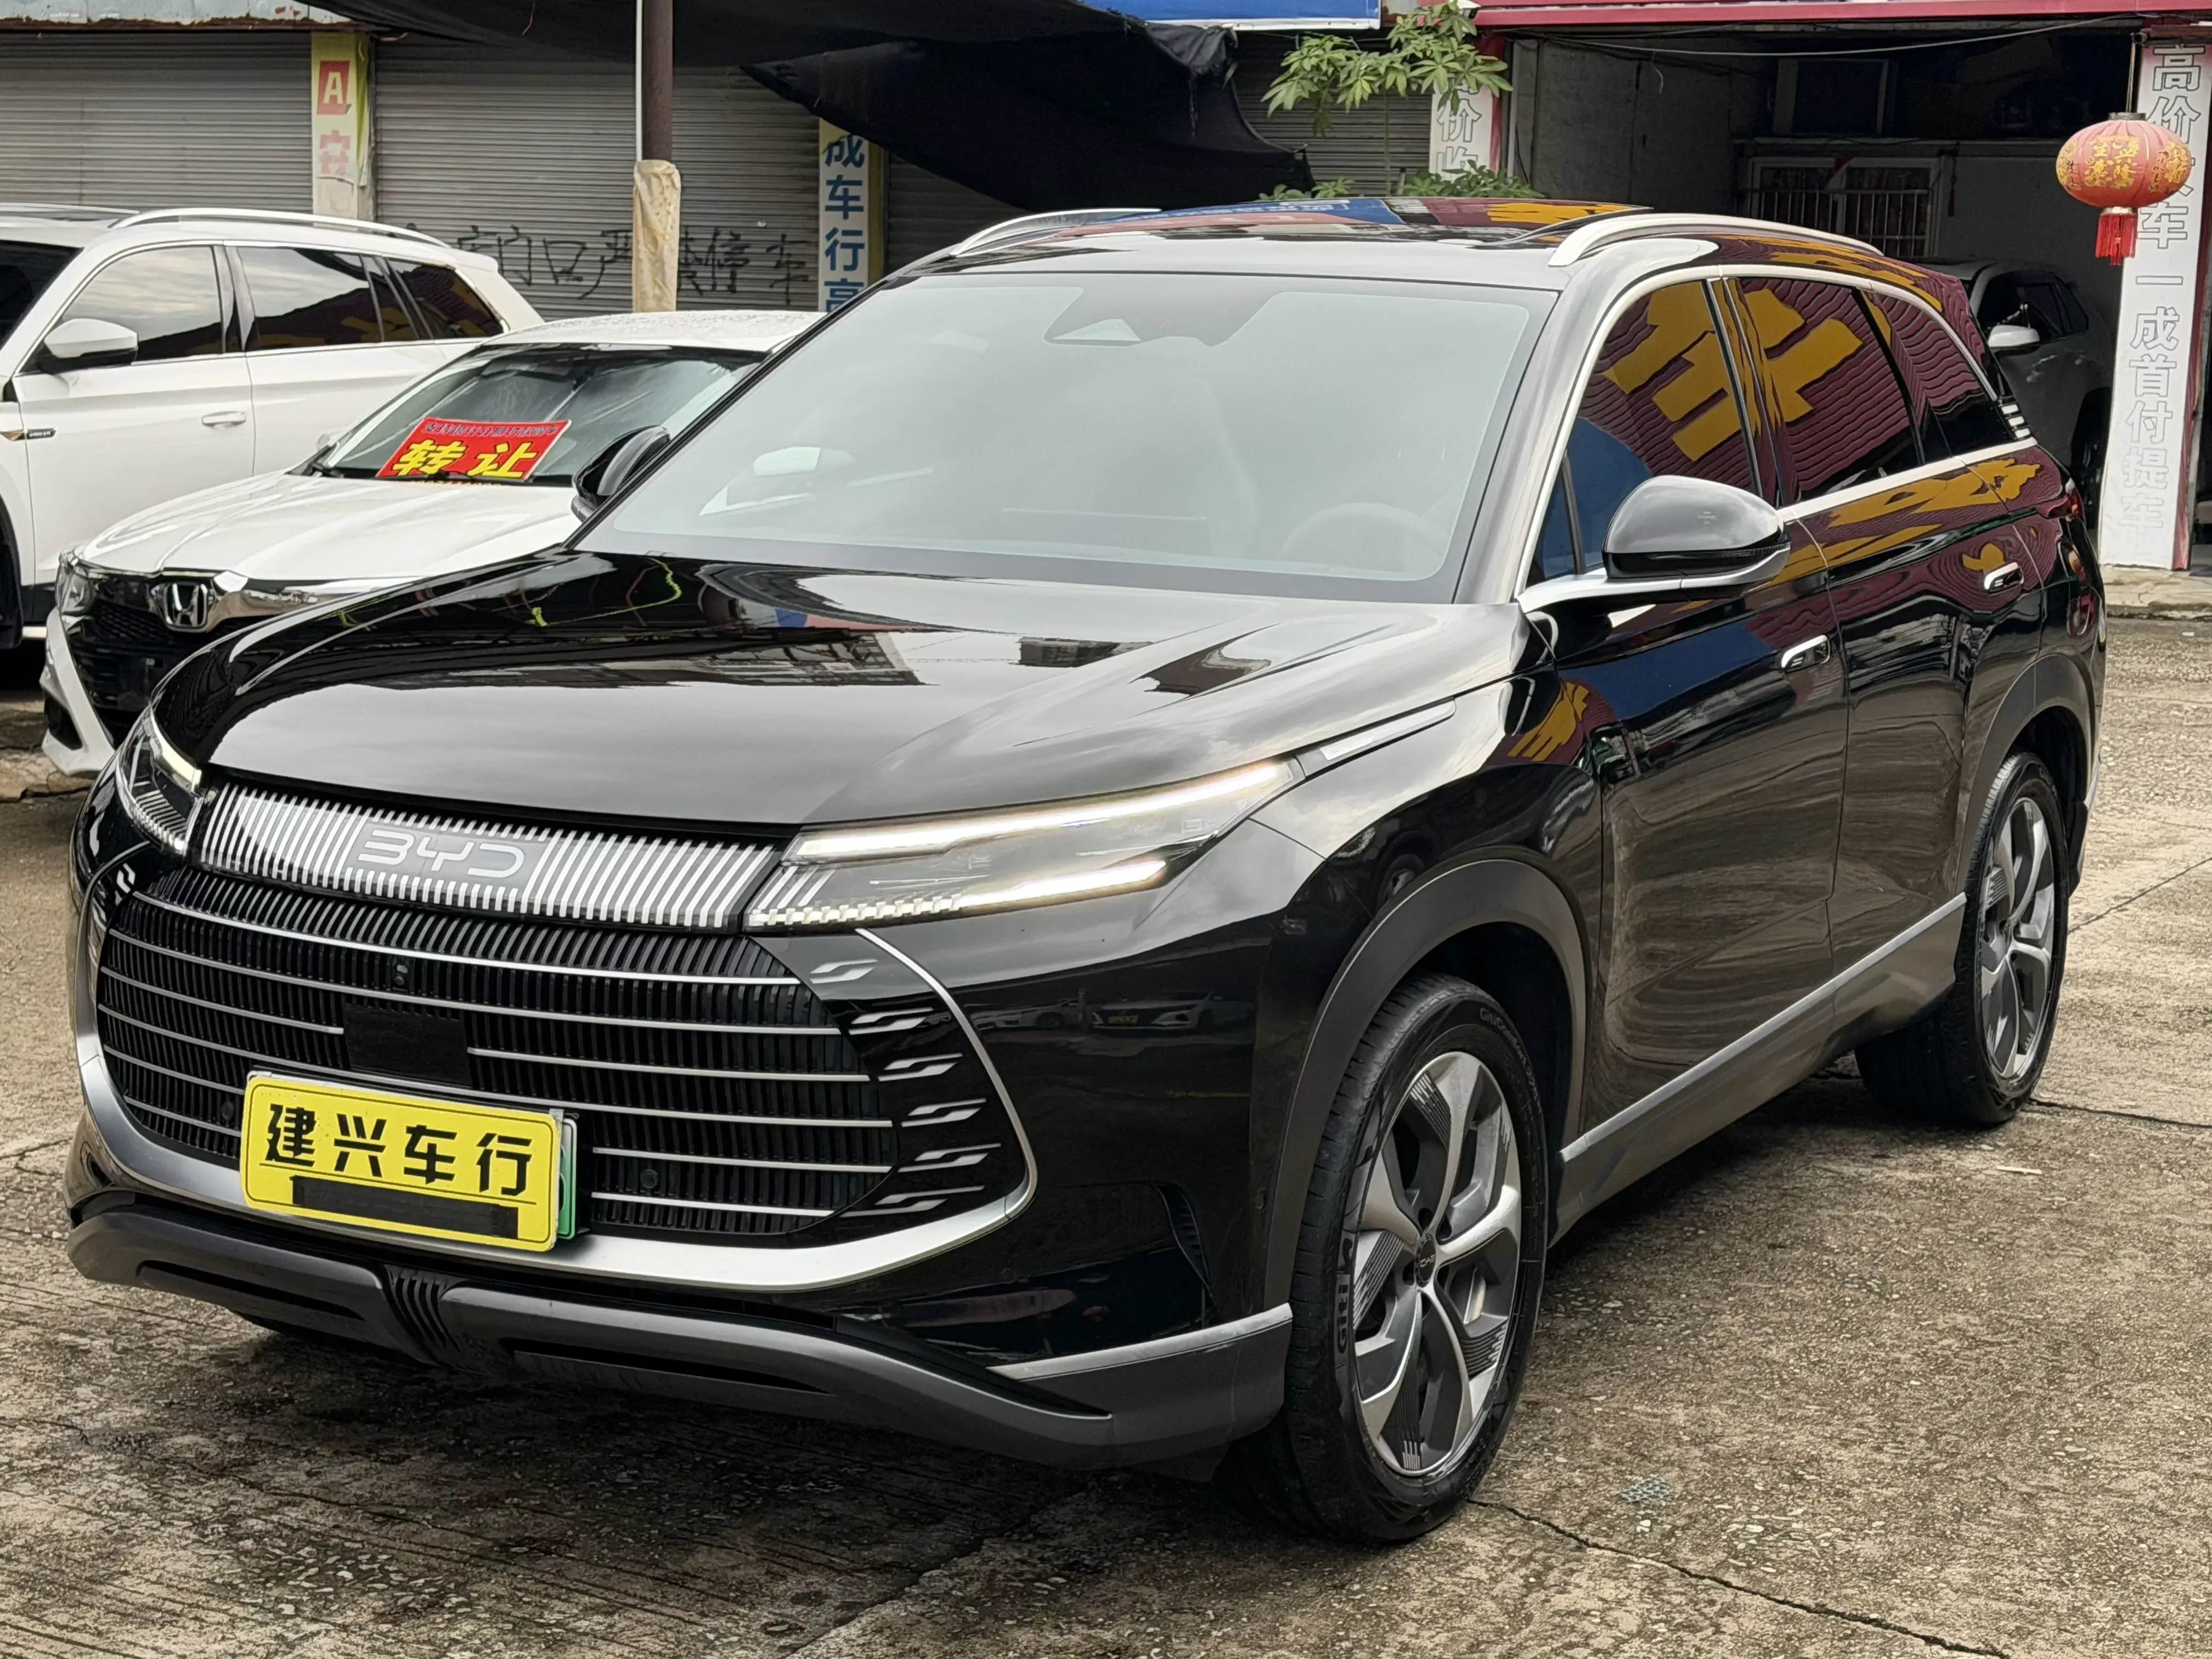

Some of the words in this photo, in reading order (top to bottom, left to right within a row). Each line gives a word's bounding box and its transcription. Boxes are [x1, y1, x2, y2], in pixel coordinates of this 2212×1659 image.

[2118, 46, 2205, 534] 高价车一成首付提车
[392, 438, 538, 478] 转让
[358, 830, 526, 879] BYD
[266, 1103, 532, 1196] 建兴车行
[1338, 1284, 1349, 1354] Giti
